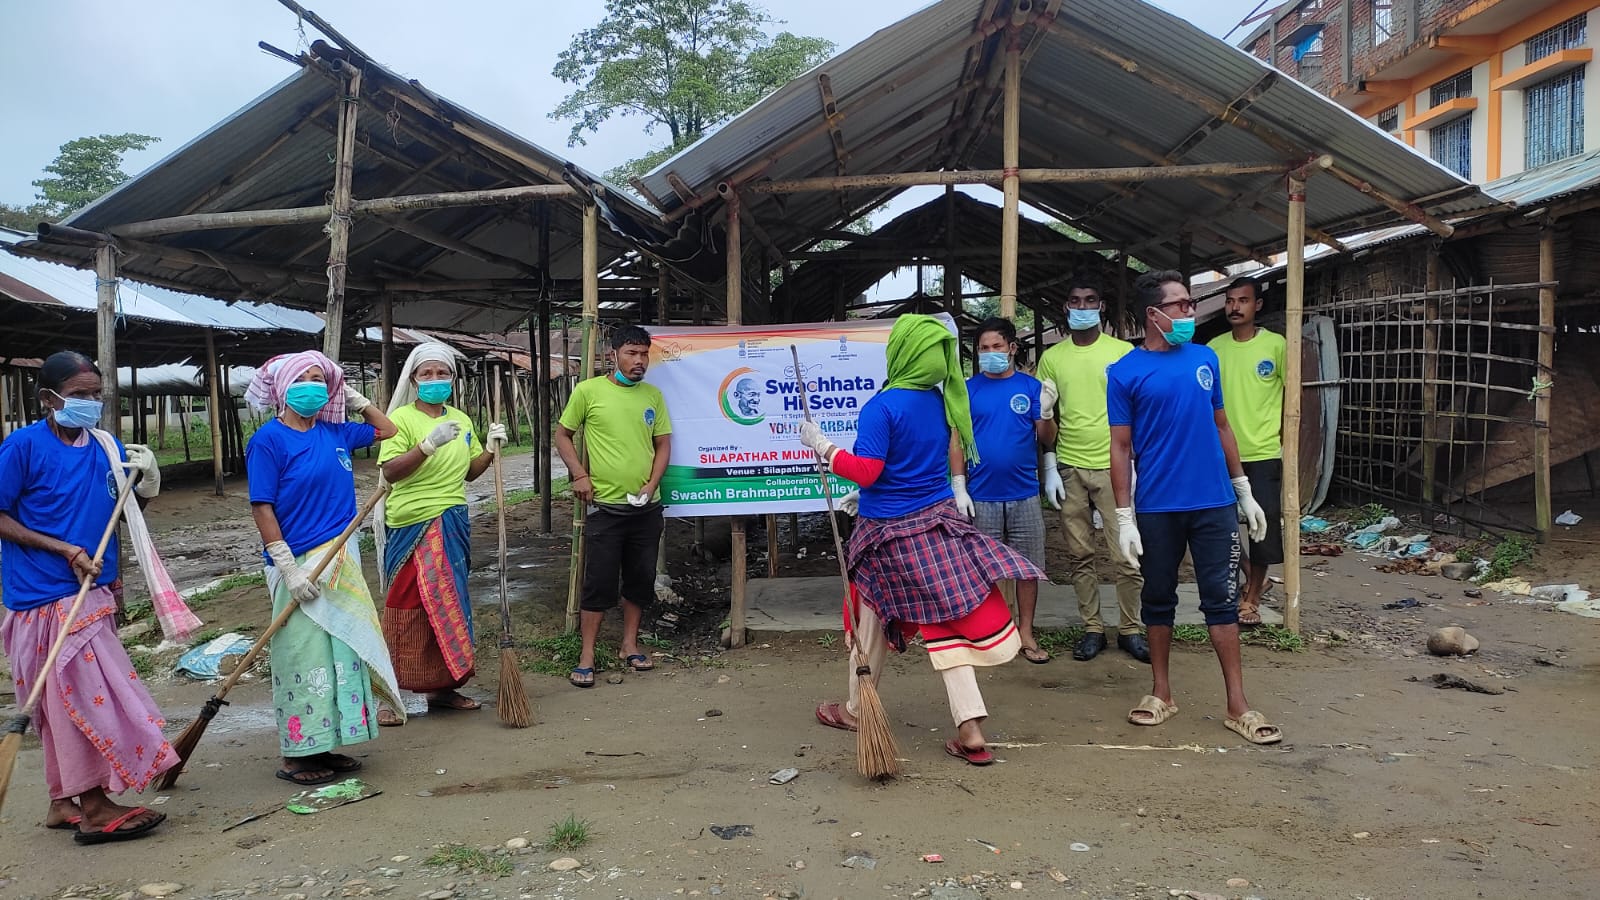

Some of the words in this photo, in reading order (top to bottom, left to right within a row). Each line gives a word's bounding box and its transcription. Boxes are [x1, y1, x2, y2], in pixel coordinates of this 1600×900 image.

[765, 376, 875, 394] Swachhata
[784, 395, 803, 411] Hi
[809, 394, 858, 410] Seva
[700, 451, 778, 464] SILAPATHAR
[781, 449, 814, 460] MUNI
[726, 468, 755, 476] Venue
[763, 465, 811, 475] Silapathar
[765, 476, 818, 486] Collaboration
[821, 476, 838, 484] ith
[671, 488, 721, 501] Swachh
[726, 485, 811, 500] Brahmaputra
[815, 483, 855, 496] Vlley
